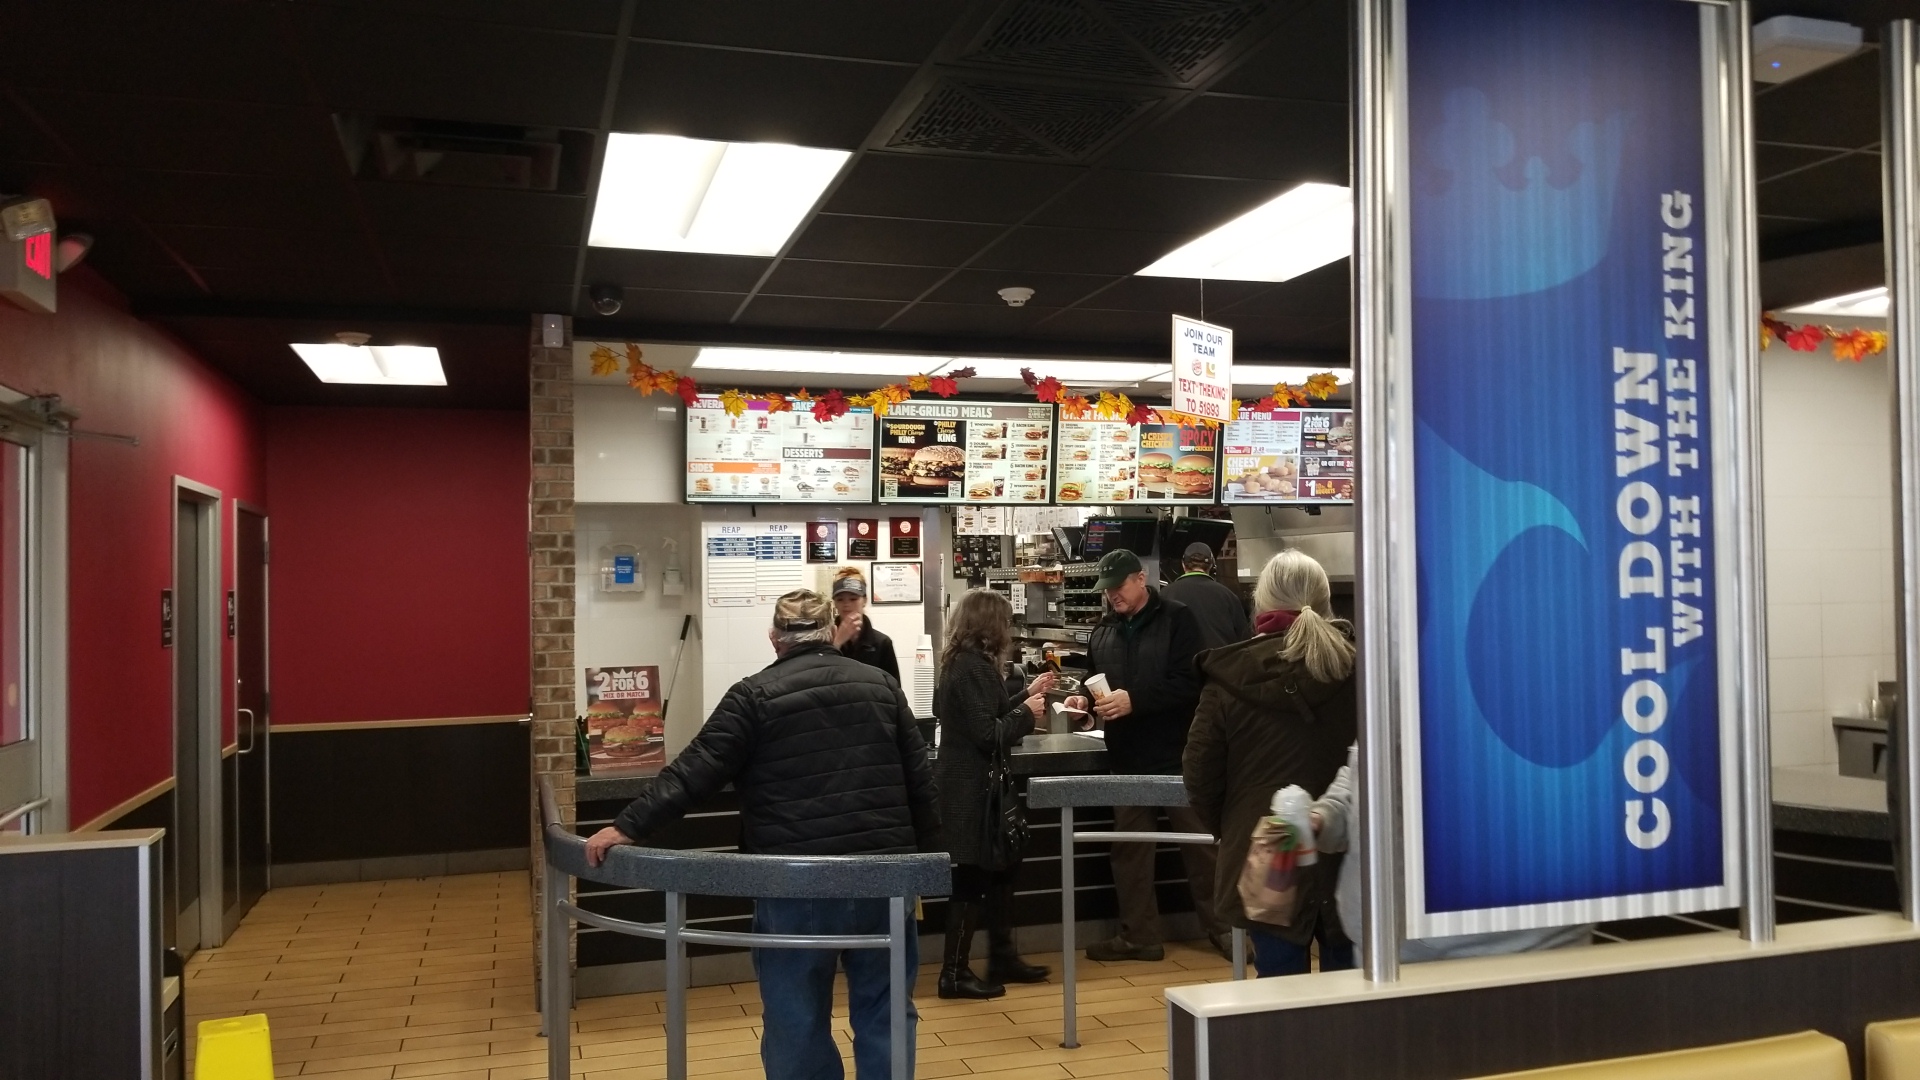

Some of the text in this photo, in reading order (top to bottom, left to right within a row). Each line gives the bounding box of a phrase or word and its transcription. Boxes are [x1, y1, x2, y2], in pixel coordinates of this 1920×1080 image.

[1184, 327, 1223, 346] JOIN OUR
[1192, 342, 1216, 357] TEAM
[1179, 378, 1196, 394] TEXT
[962, 406, 992, 418] MEALS
[1186, 398, 1220, 417] TO 51893
[1251, 412, 1272, 420] MENU
[1304, 416, 1311, 428] 2
[1661, 190, 1703, 647] WITH THE KING
[937, 434, 957, 442] KING
[1180, 428, 1214, 446] SPICY
[784, 448, 824, 458] DESSERTS
[690, 463, 714, 472] SIDES
[1227, 457, 1260, 468] CHEESY
[1227, 467, 1243, 476] TOTS
[1613, 347, 1671, 849] COOL DOWN
[594, 672, 611, 692] 2
[612, 678, 635, 691] FOR
